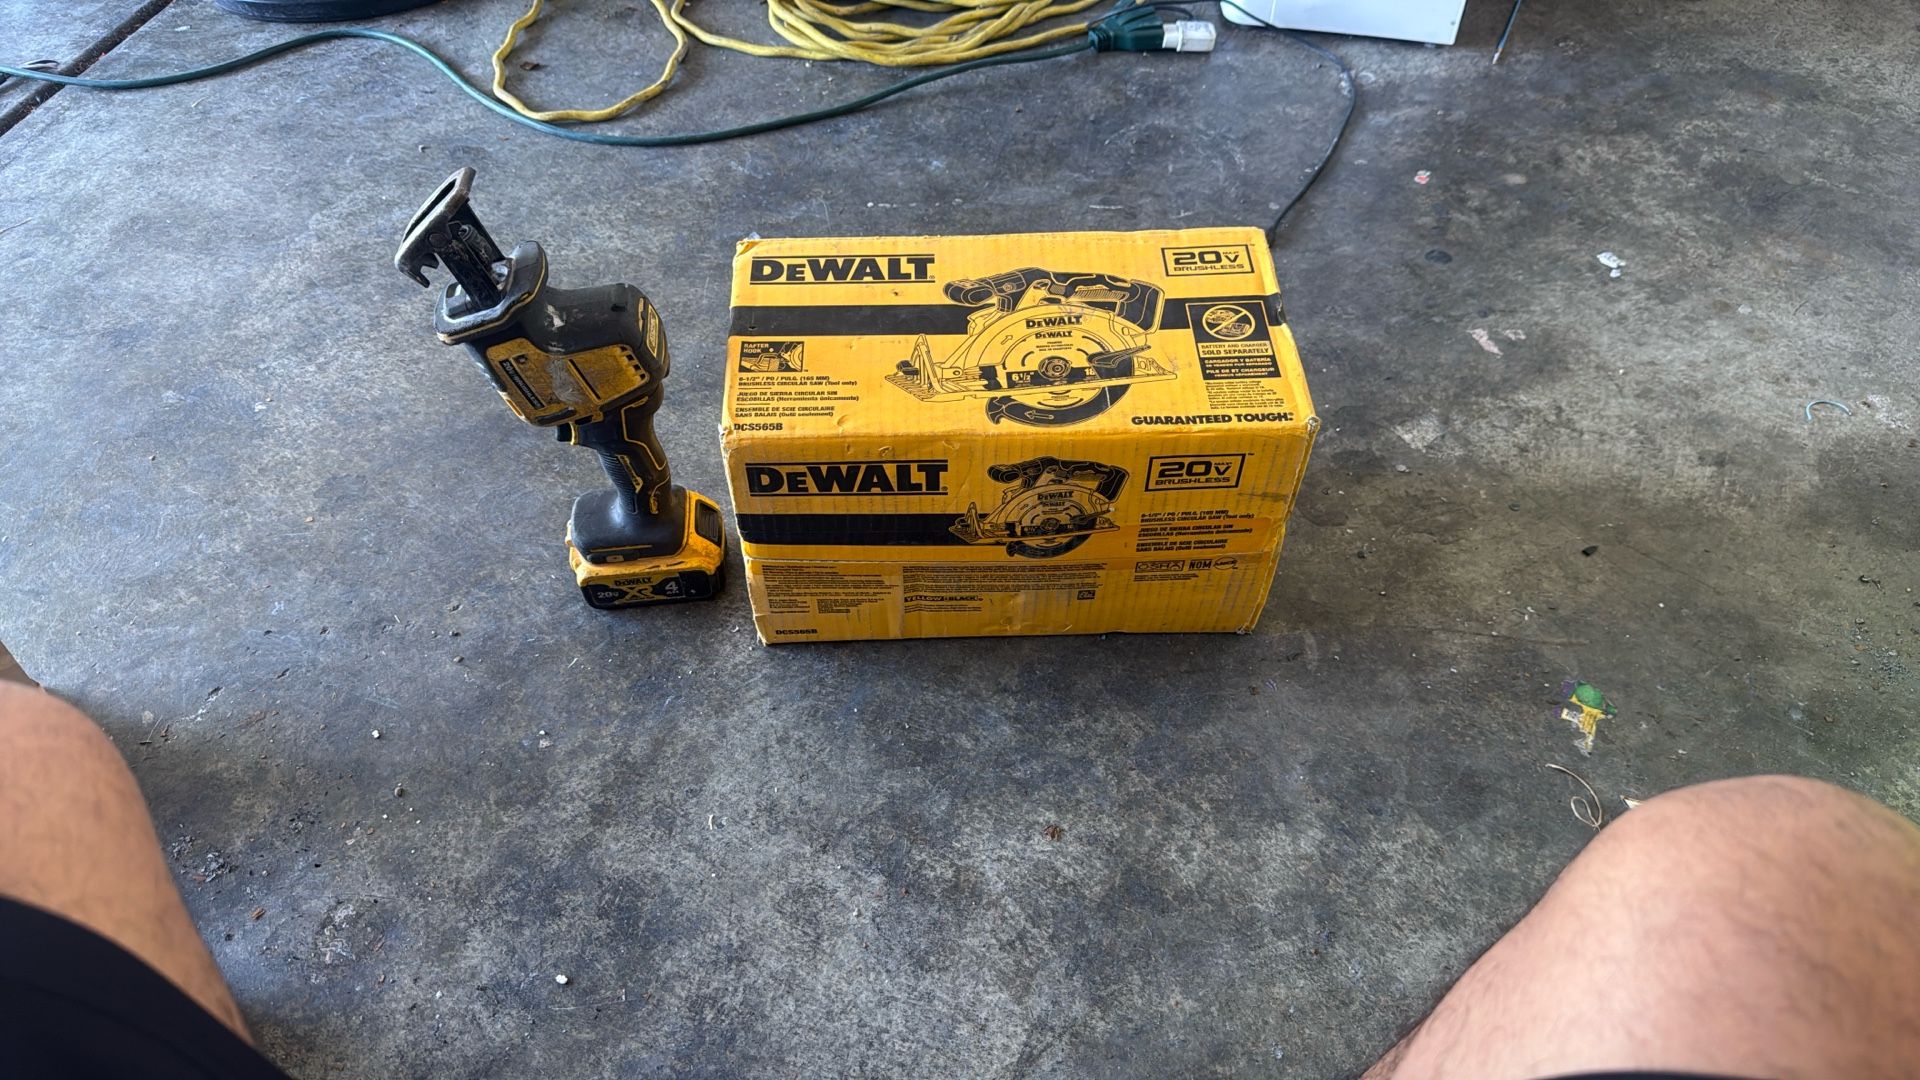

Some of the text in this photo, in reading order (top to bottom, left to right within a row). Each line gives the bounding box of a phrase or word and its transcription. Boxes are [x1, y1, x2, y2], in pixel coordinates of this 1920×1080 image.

[1131, 414, 1232, 425] GUARANTEED
[734, 423, 783, 431] DCS565B
[1155, 477, 1230, 486] BRUSHLESS
[1188, 559, 1213, 569] NOM
[665, 581, 678, 592] 4
